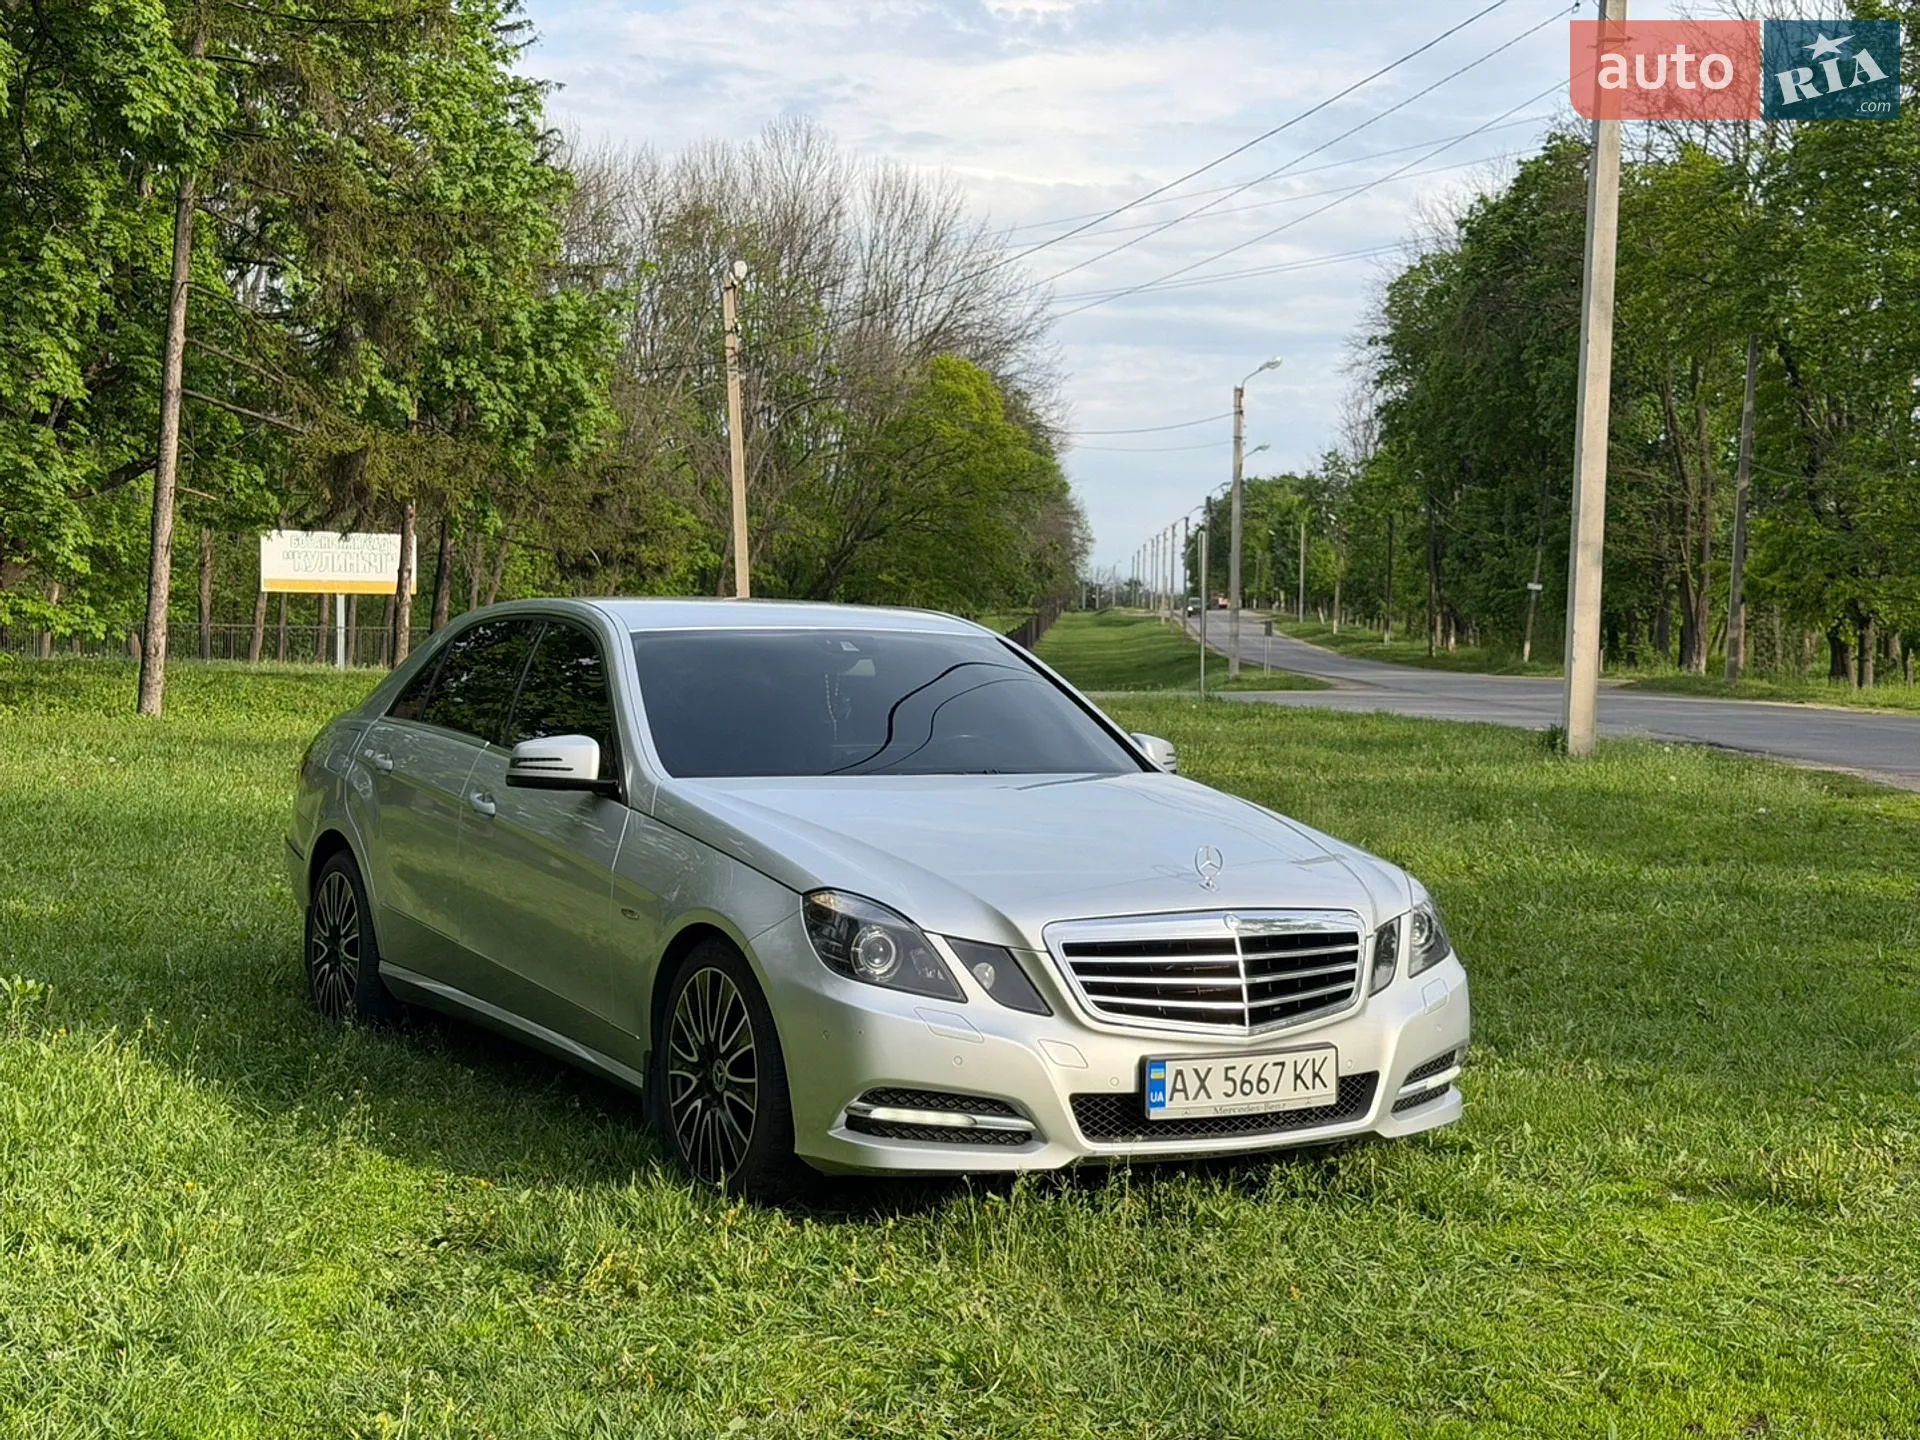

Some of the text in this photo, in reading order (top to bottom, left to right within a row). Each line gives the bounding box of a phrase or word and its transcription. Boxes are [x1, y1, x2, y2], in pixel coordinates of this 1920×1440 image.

[1168, 1056, 1328, 1102] AX 5667 KK
[1149, 1091, 1164, 1103] UA
